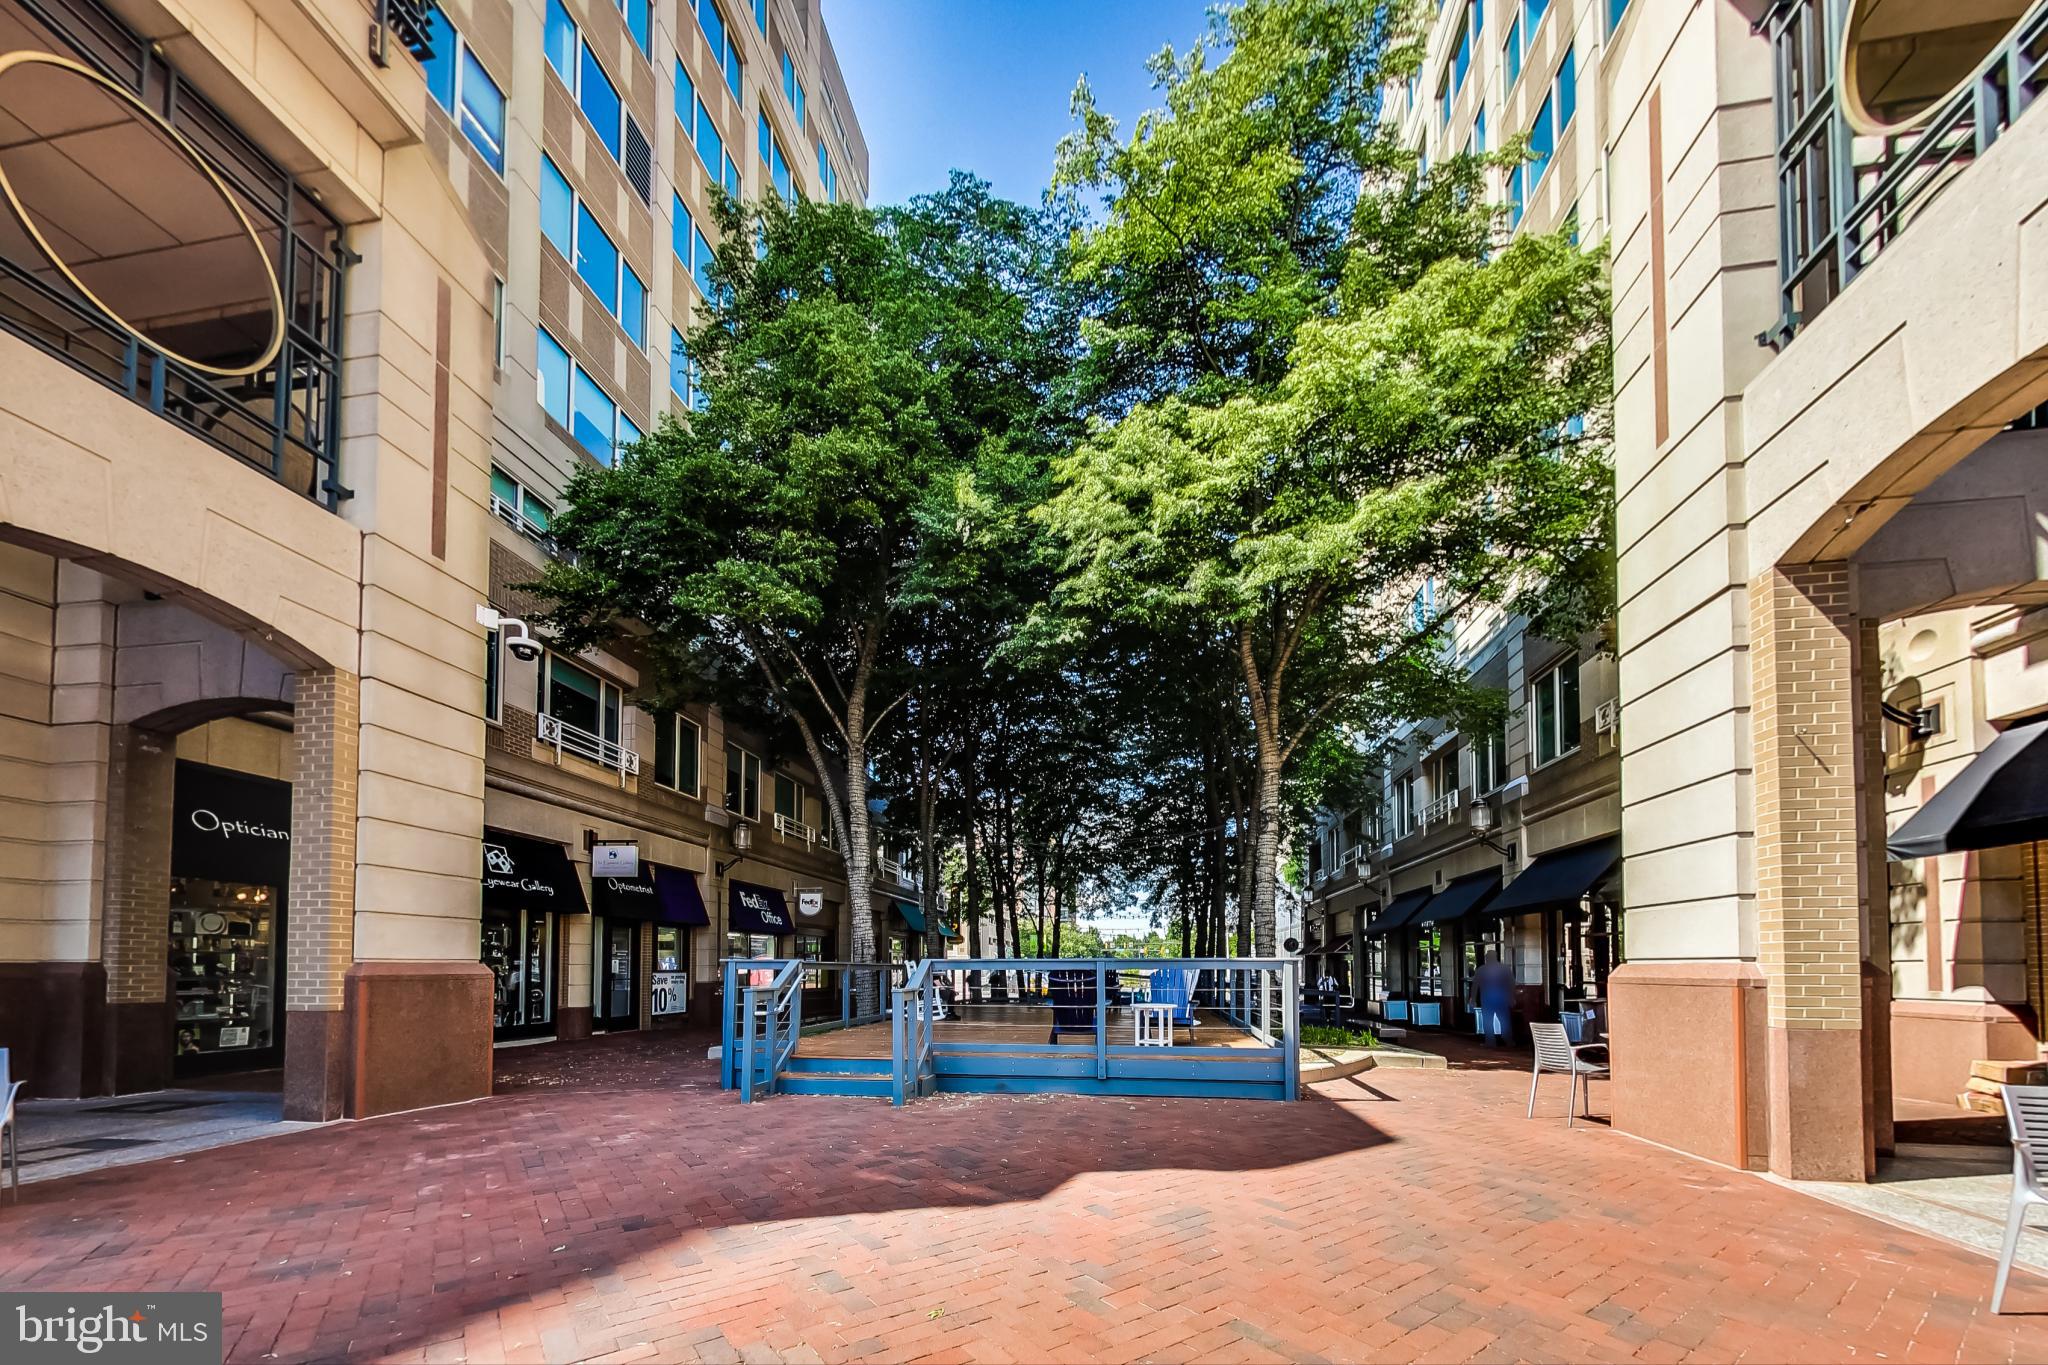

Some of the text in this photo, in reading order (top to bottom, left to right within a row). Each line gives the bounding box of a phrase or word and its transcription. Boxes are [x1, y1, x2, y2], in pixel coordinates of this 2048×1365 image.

[191, 809, 290, 840] Optician
[483, 878, 554, 896] yewear Gallery
[607, 877, 654, 894] Optometrist
[739, 890, 771, 910] FedEx
[760, 910, 783, 925] Office
[652, 974, 668, 985] Save
[652, 987, 677, 1013] 10%
